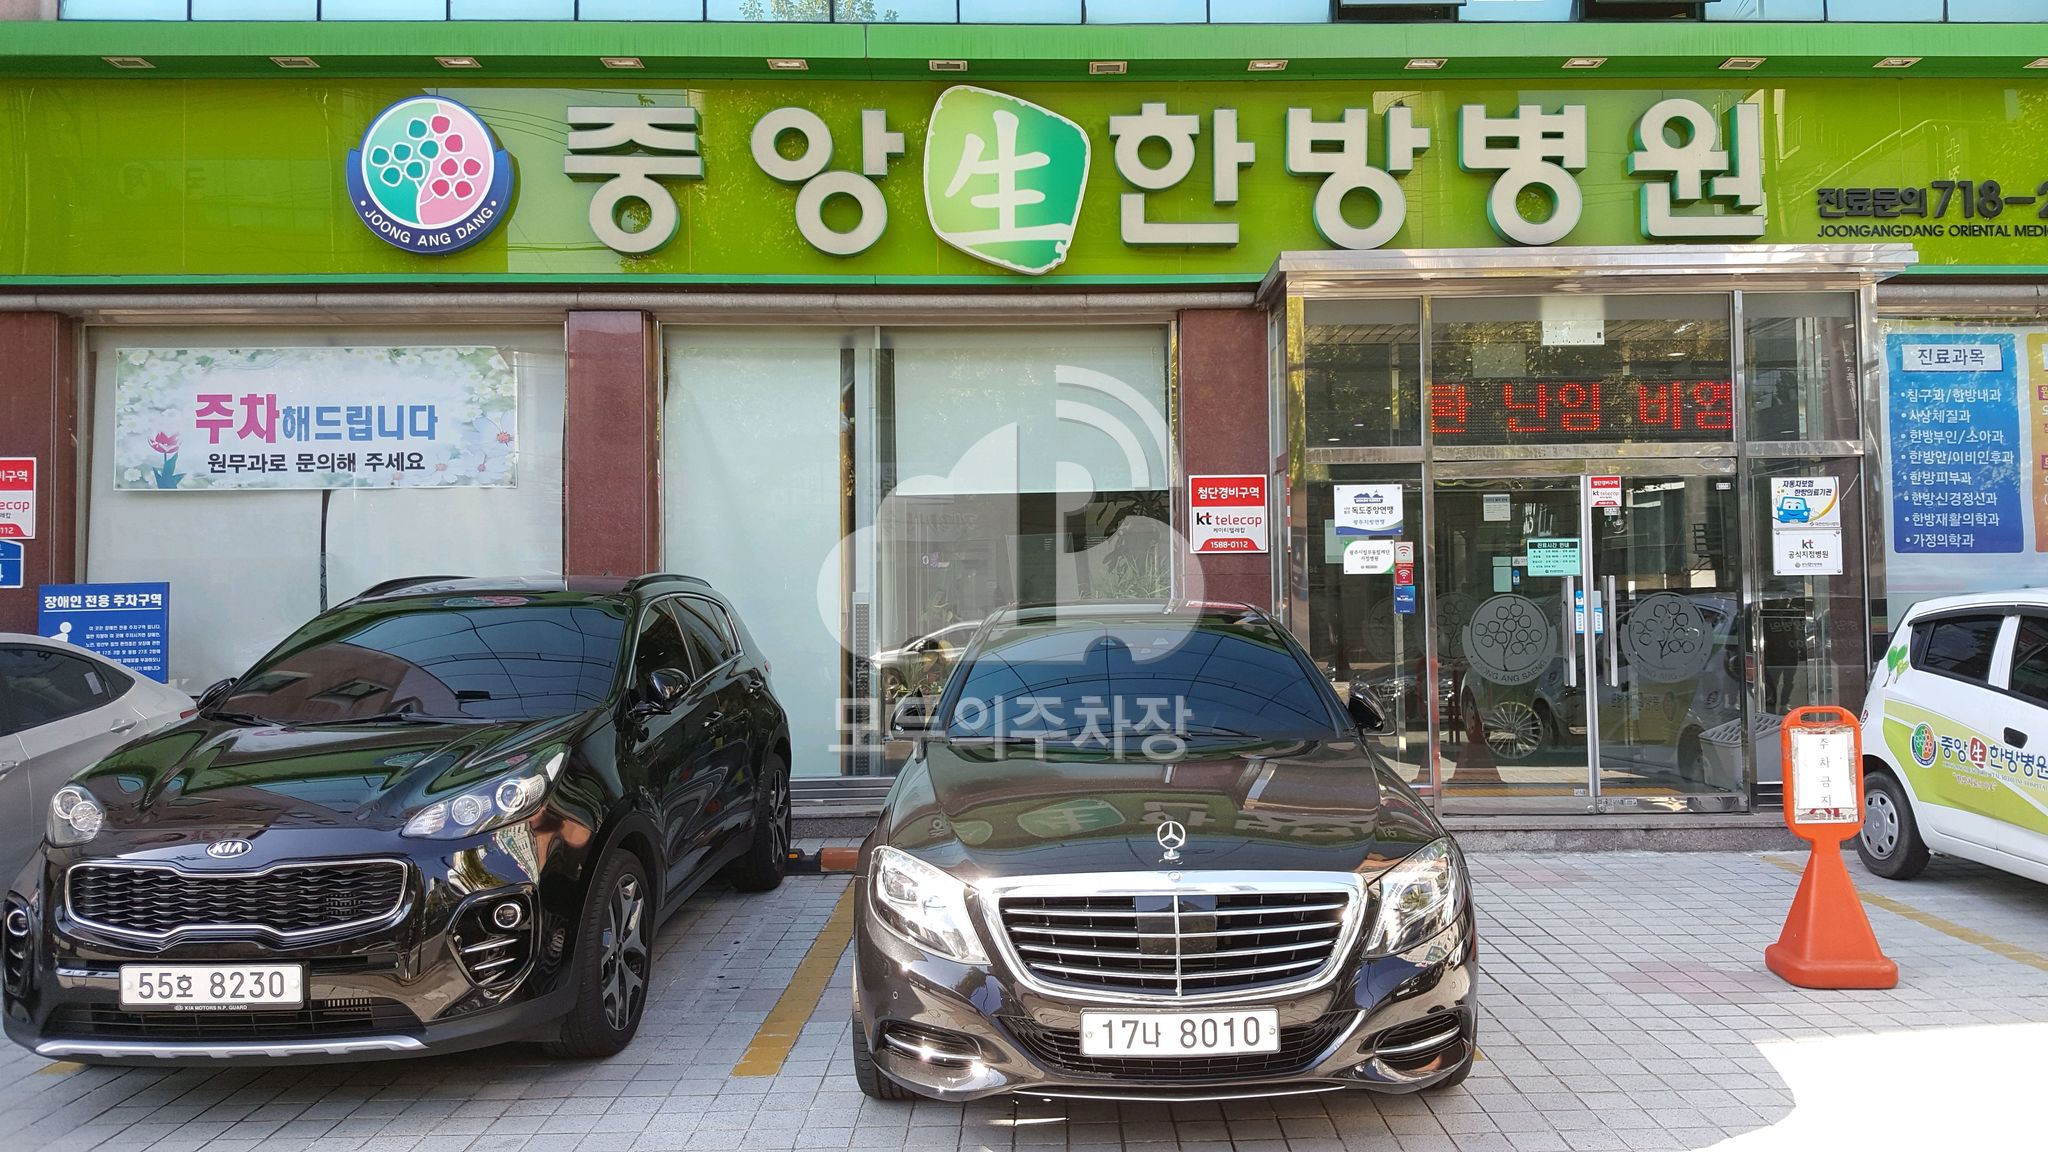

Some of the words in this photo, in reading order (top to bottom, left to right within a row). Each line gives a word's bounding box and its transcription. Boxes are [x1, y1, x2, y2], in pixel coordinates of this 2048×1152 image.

[1817, 187, 1927, 219] 진료문의
[365, 209, 411, 244] JOONG
[417, 232, 452, 247] ANG
[455, 206, 494, 240] DANG
[1817, 224, 1945, 237] JOONGANGDANG
[1948, 223, 2011, 237] ORIENTAL
[2014, 224, 2048, 237] MEDI
[1917, 348, 1986, 366] 진료과목
[1907, 388, 2001, 403] 침구과/한방내과
[1503, 381, 1601, 433] 난임
[1638, 380, 1732, 431] 비염
[195, 393, 438, 443] 주차해드립니다
[1909, 409, 1971, 424] 사상체질과
[1909, 429, 2004, 444] 한방부인/소아과
[207, 453, 288, 474] 원무과로
[295, 452, 357, 473] 문의해
[364, 451, 426, 472] 주세요
[1909, 471, 1972, 486] 한방피부과
[1197, 486, 1260, 499] 첨단경비구역
[1196, 512, 1212, 525] kt
[1214, 514, 1262, 527] telecop
[1912, 512, 2000, 527] 한방재활의학과
[1210, 541, 1249, 549] 1588-0112
[1801, 539, 1814, 549] kt
[1913, 533, 1975, 548] 가정의학과
[44, 595, 82, 609] 장애인
[85, 594, 110, 608] 전용
[113, 593, 162, 607] 주차구역
[211, 841, 244, 855] KIA
[137, 971, 194, 999] 55호
[209, 970, 285, 999] 8230
[1102, 1018, 1162, 1049] 17나
[1179, 1016, 1260, 1049] 8010
